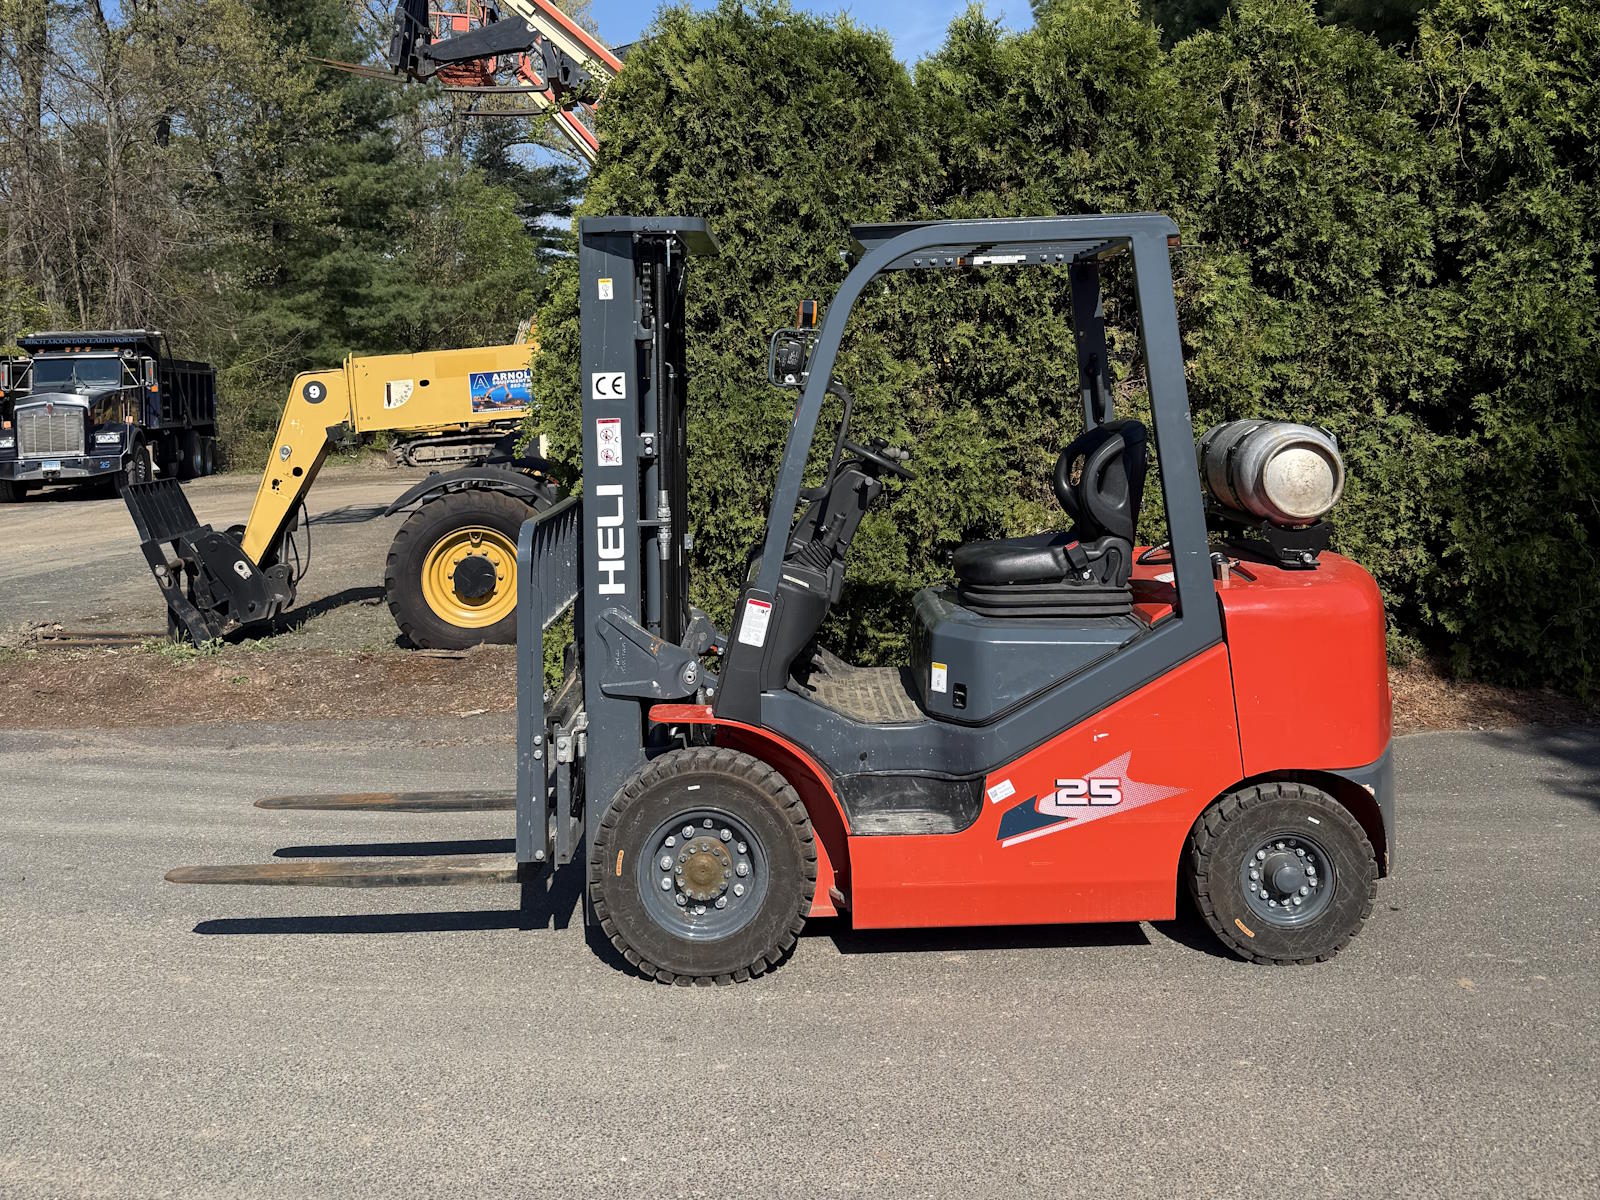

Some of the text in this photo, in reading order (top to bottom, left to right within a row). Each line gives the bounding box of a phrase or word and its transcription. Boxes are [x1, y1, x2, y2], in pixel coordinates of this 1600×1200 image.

[89, 336, 137, 344] EARTHWORKS
[308, 385, 320, 399] 9
[595, 376, 623, 396] CE
[596, 484, 626, 595] HELI
[1055, 777, 1123, 806] 25
